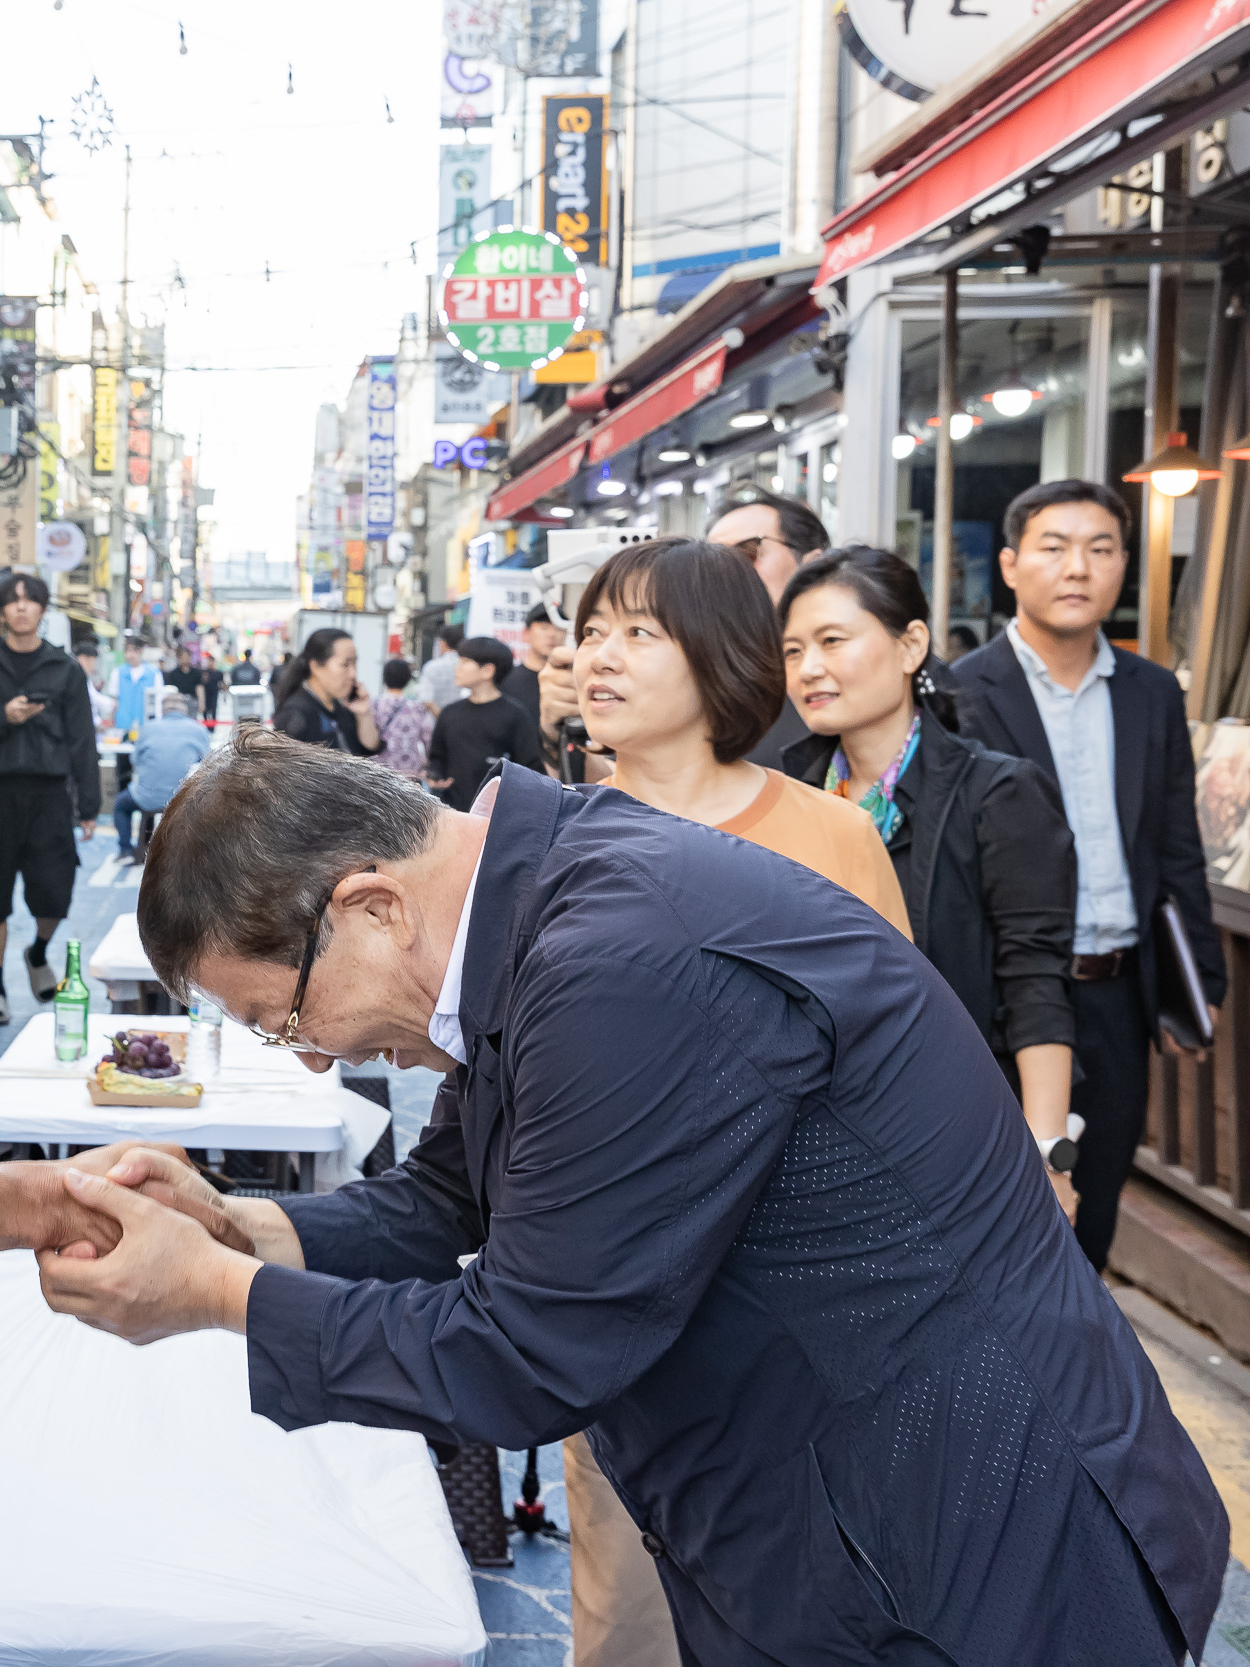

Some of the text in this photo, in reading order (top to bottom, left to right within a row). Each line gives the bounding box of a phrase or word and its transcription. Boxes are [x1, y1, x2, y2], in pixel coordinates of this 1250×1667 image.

[452, 278, 577, 319] 갈비살
[476, 325, 549, 355] 2호점
[434, 437, 488, 470] PC
